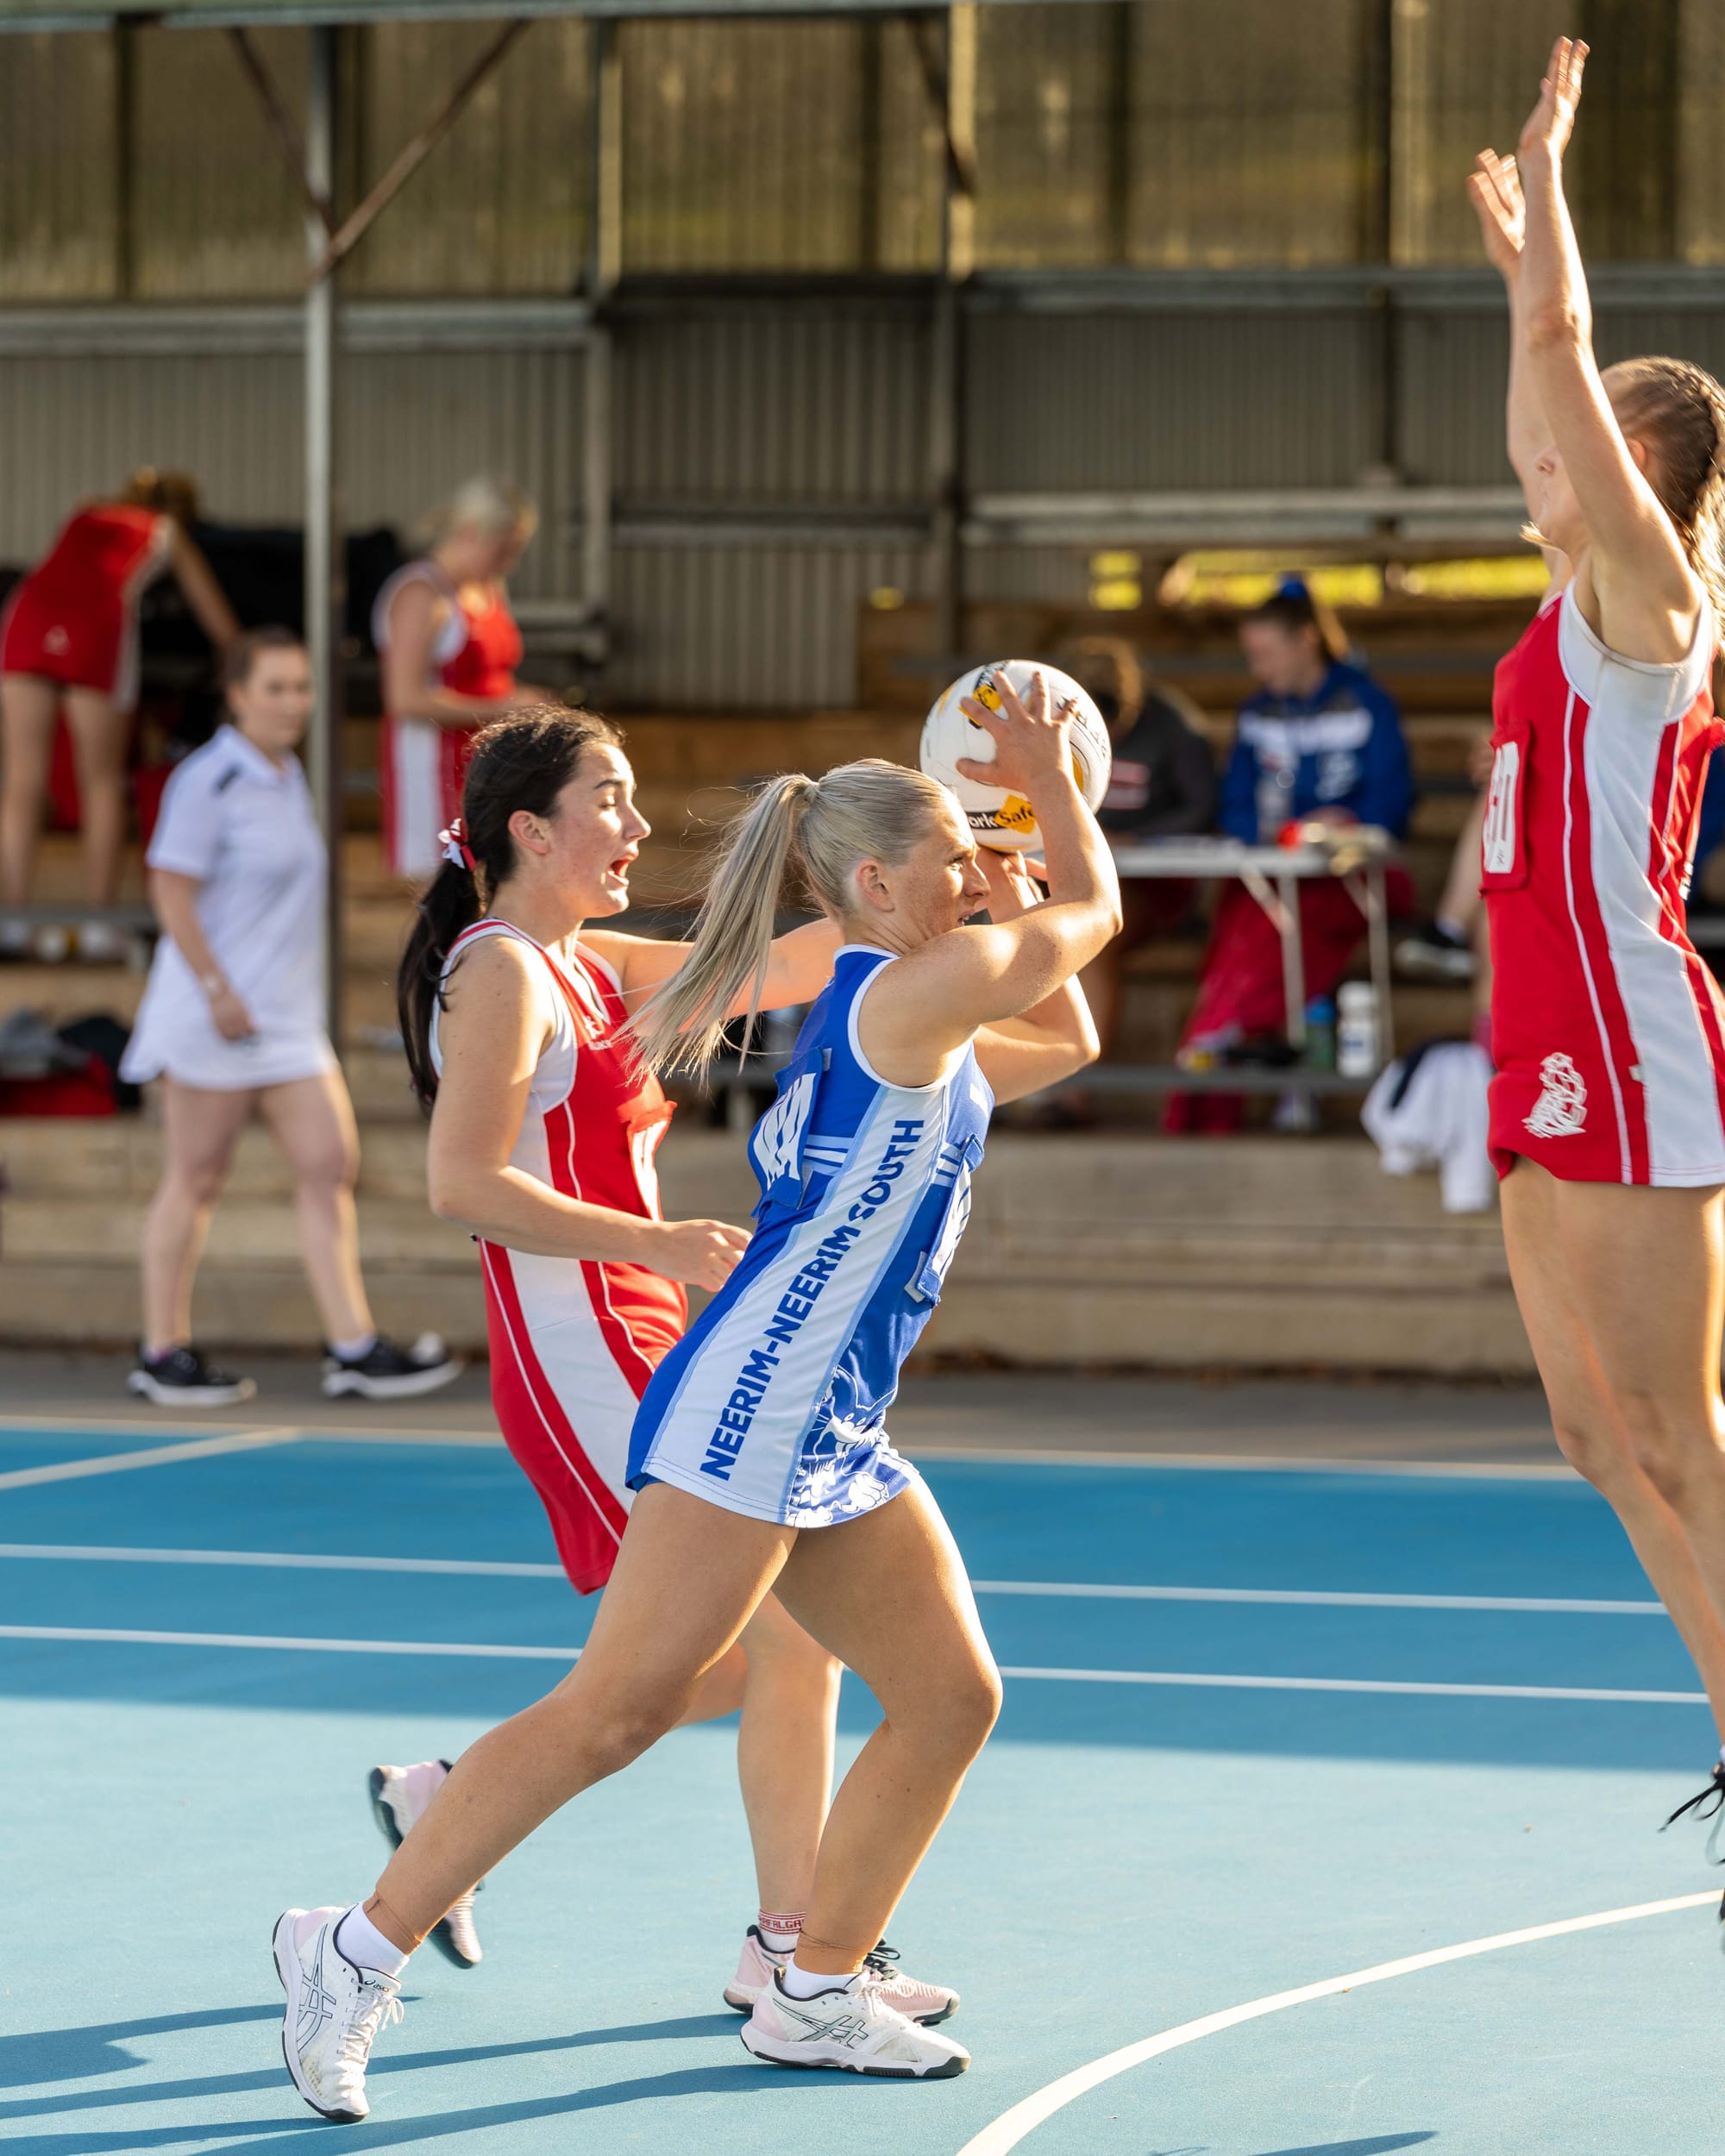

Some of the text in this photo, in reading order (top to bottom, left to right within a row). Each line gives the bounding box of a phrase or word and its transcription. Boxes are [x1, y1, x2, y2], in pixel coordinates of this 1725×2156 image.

[969, 806, 1033, 828] orkSafe
[700, 1225, 861, 1481] NEERIM-NEERIM
[848, 1120, 925, 1221] SOUTH
